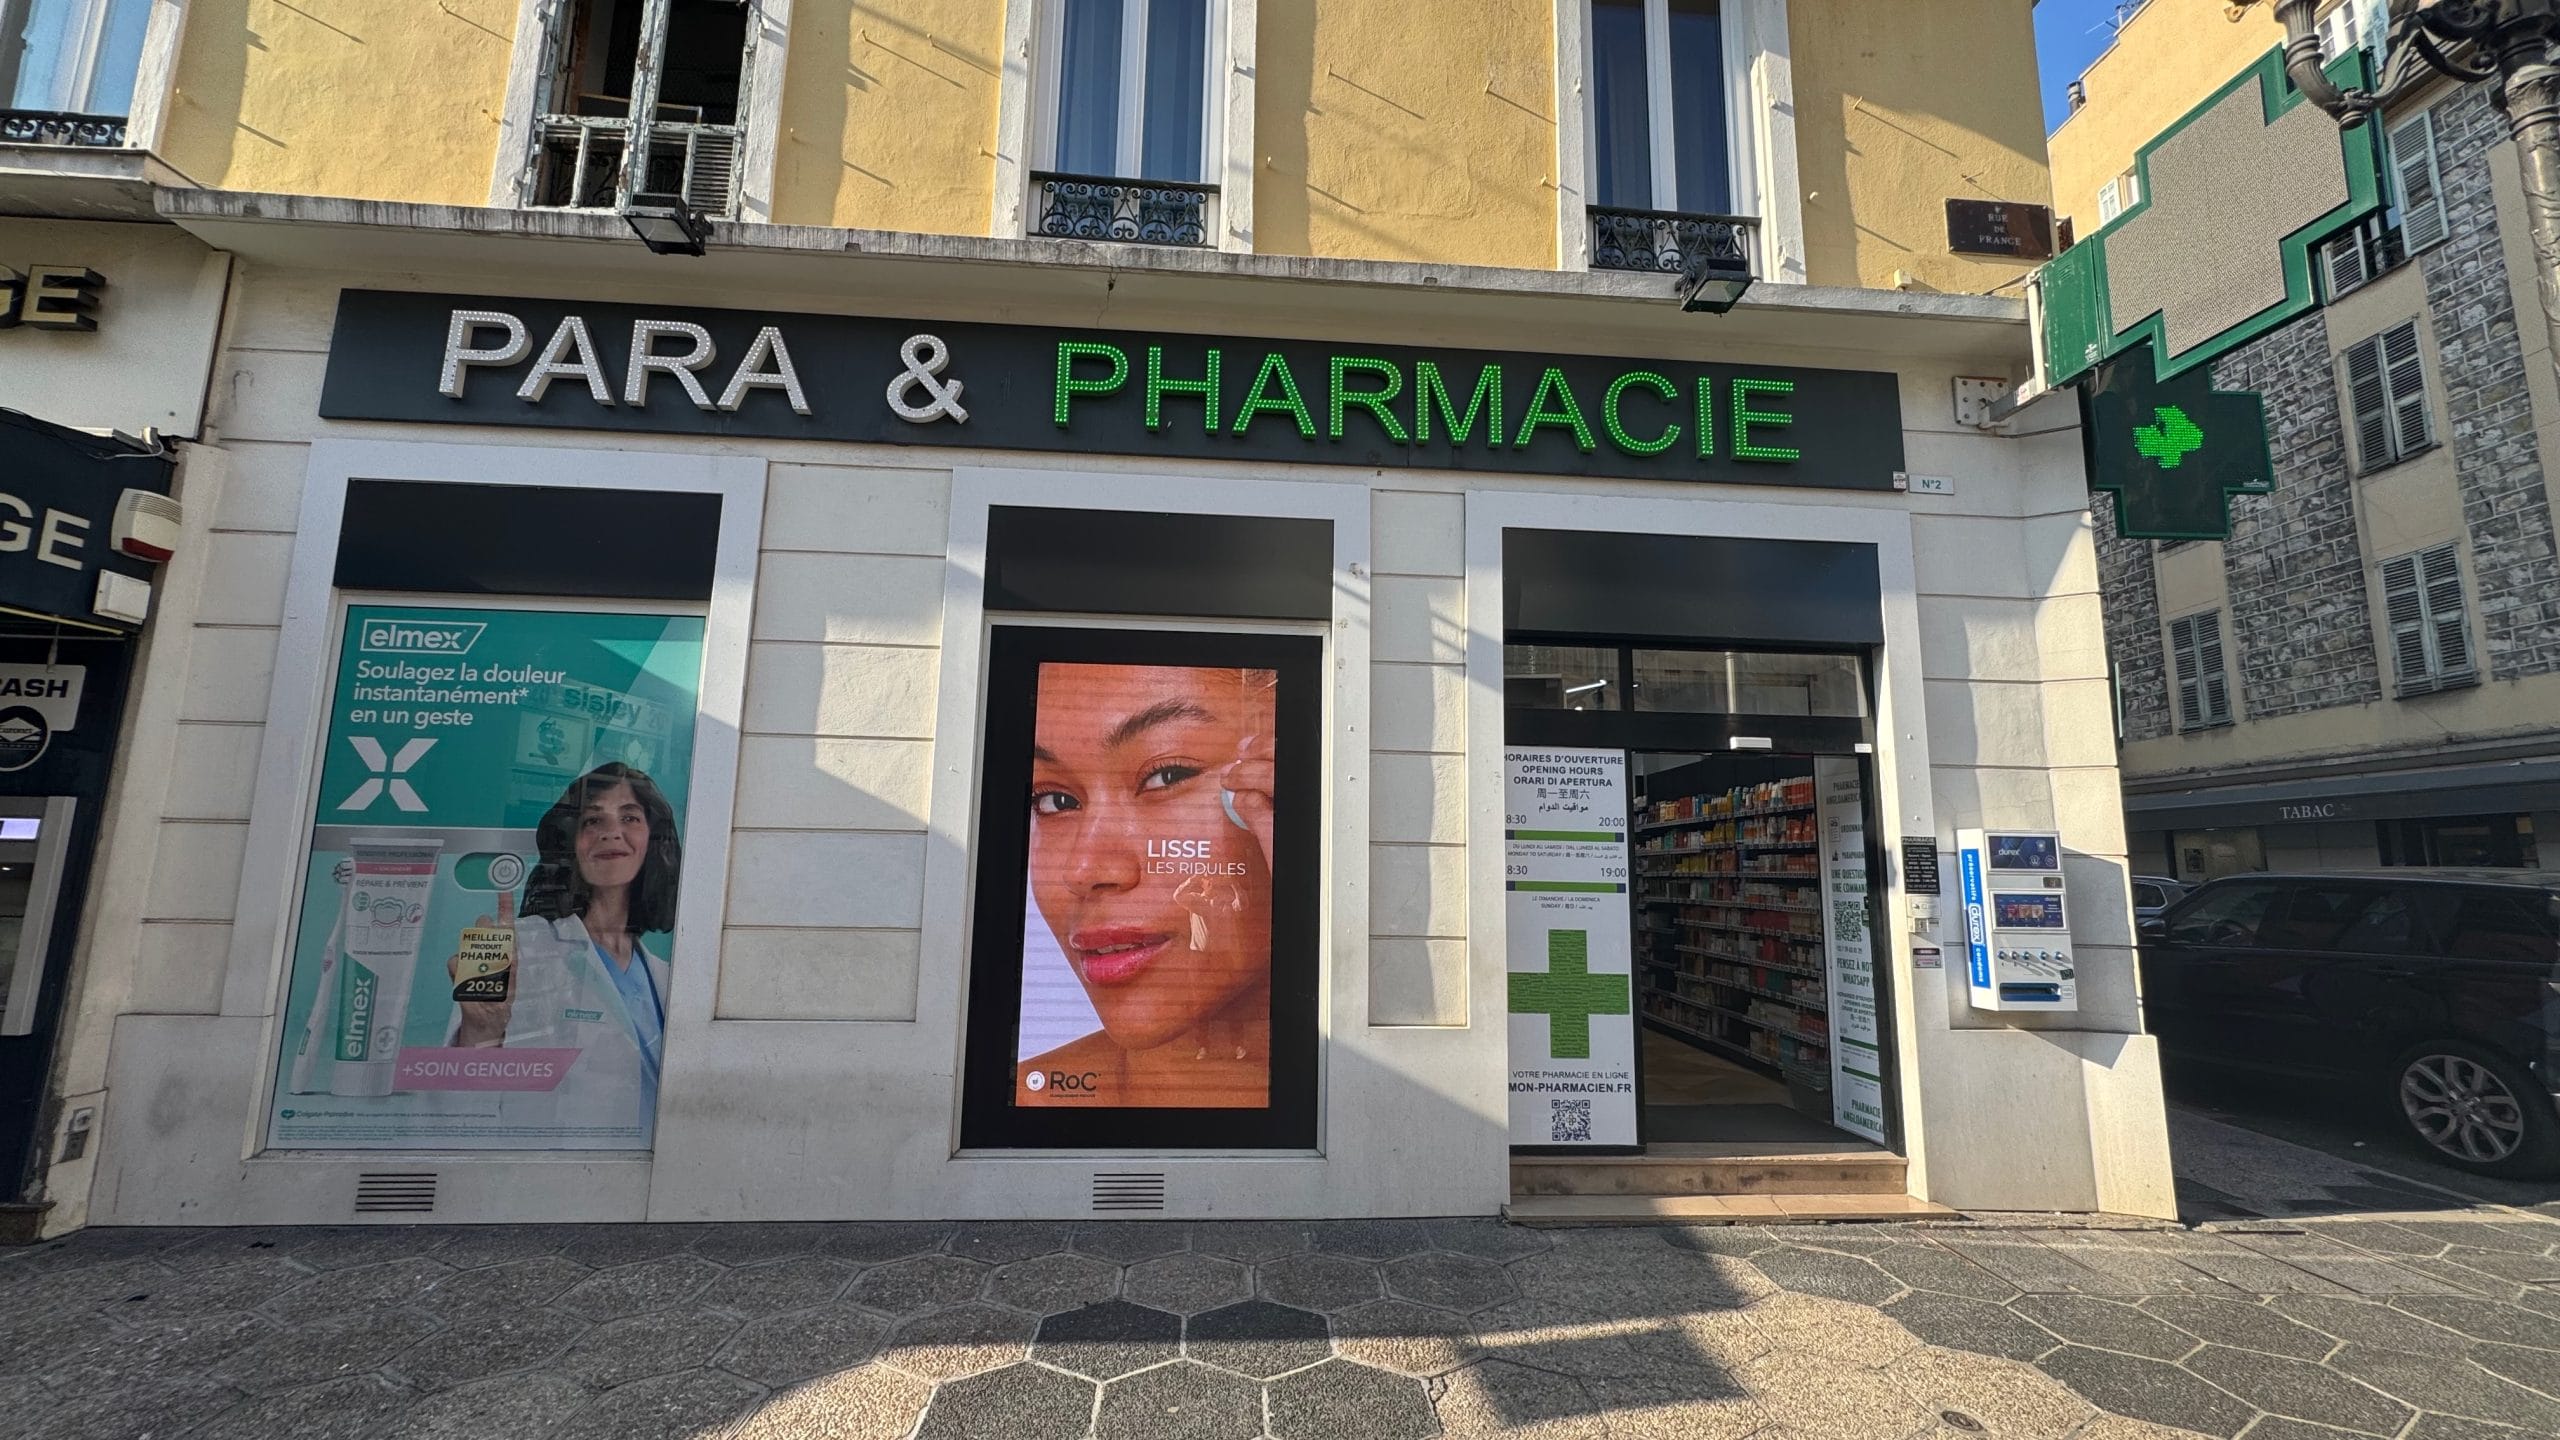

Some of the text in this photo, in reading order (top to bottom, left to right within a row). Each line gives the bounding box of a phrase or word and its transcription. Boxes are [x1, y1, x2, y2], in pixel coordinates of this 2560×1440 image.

[1988, 213, 2008, 222] RUE
[1979, 235, 2021, 246] FRANCE
[0, 264, 96, 327] E
[437, 309, 1800, 461] PARA & PHARMACIE
[1922, 480, 1942, 490] N°2
[370, 624, 462, 649] elmex
[357, 660, 566, 685] Soulagez la douleur
[0, 678, 69, 698] ASH
[350, 709, 473, 730] en un geste
[1554, 755, 1624, 765] D'OUVERTURE
[1522, 765, 1603, 776] OPENING HOURS
[1514, 776, 1612, 787] ORARI DI APERTURA
[1537, 788, 1590, 800] 周一至周六
[2279, 803, 2335, 819] TABAC
[1599, 817, 1625, 827] 20:00
[1147, 840, 1211, 858] LISSE
[1147, 861, 1246, 875] LES RIDULES
[1601, 867, 1627, 877] 19:00
[1970, 906, 1981, 940] durex
[463, 933, 512, 942] MEILLEUR
[460, 952, 509, 961] PHARMA
[466, 980, 504, 992] 2026
[344, 978, 371, 1057] elmex
[402, 1062, 554, 1078] +SOIN GENCIVES
[1513, 1071, 1540, 1079] VOTRE
[1542, 1071, 1589, 1079] PHARMACIE
[1050, 1071, 1097, 1091] RoC
[1508, 1082, 1632, 1093] MON-PHARMACIEN.FR
